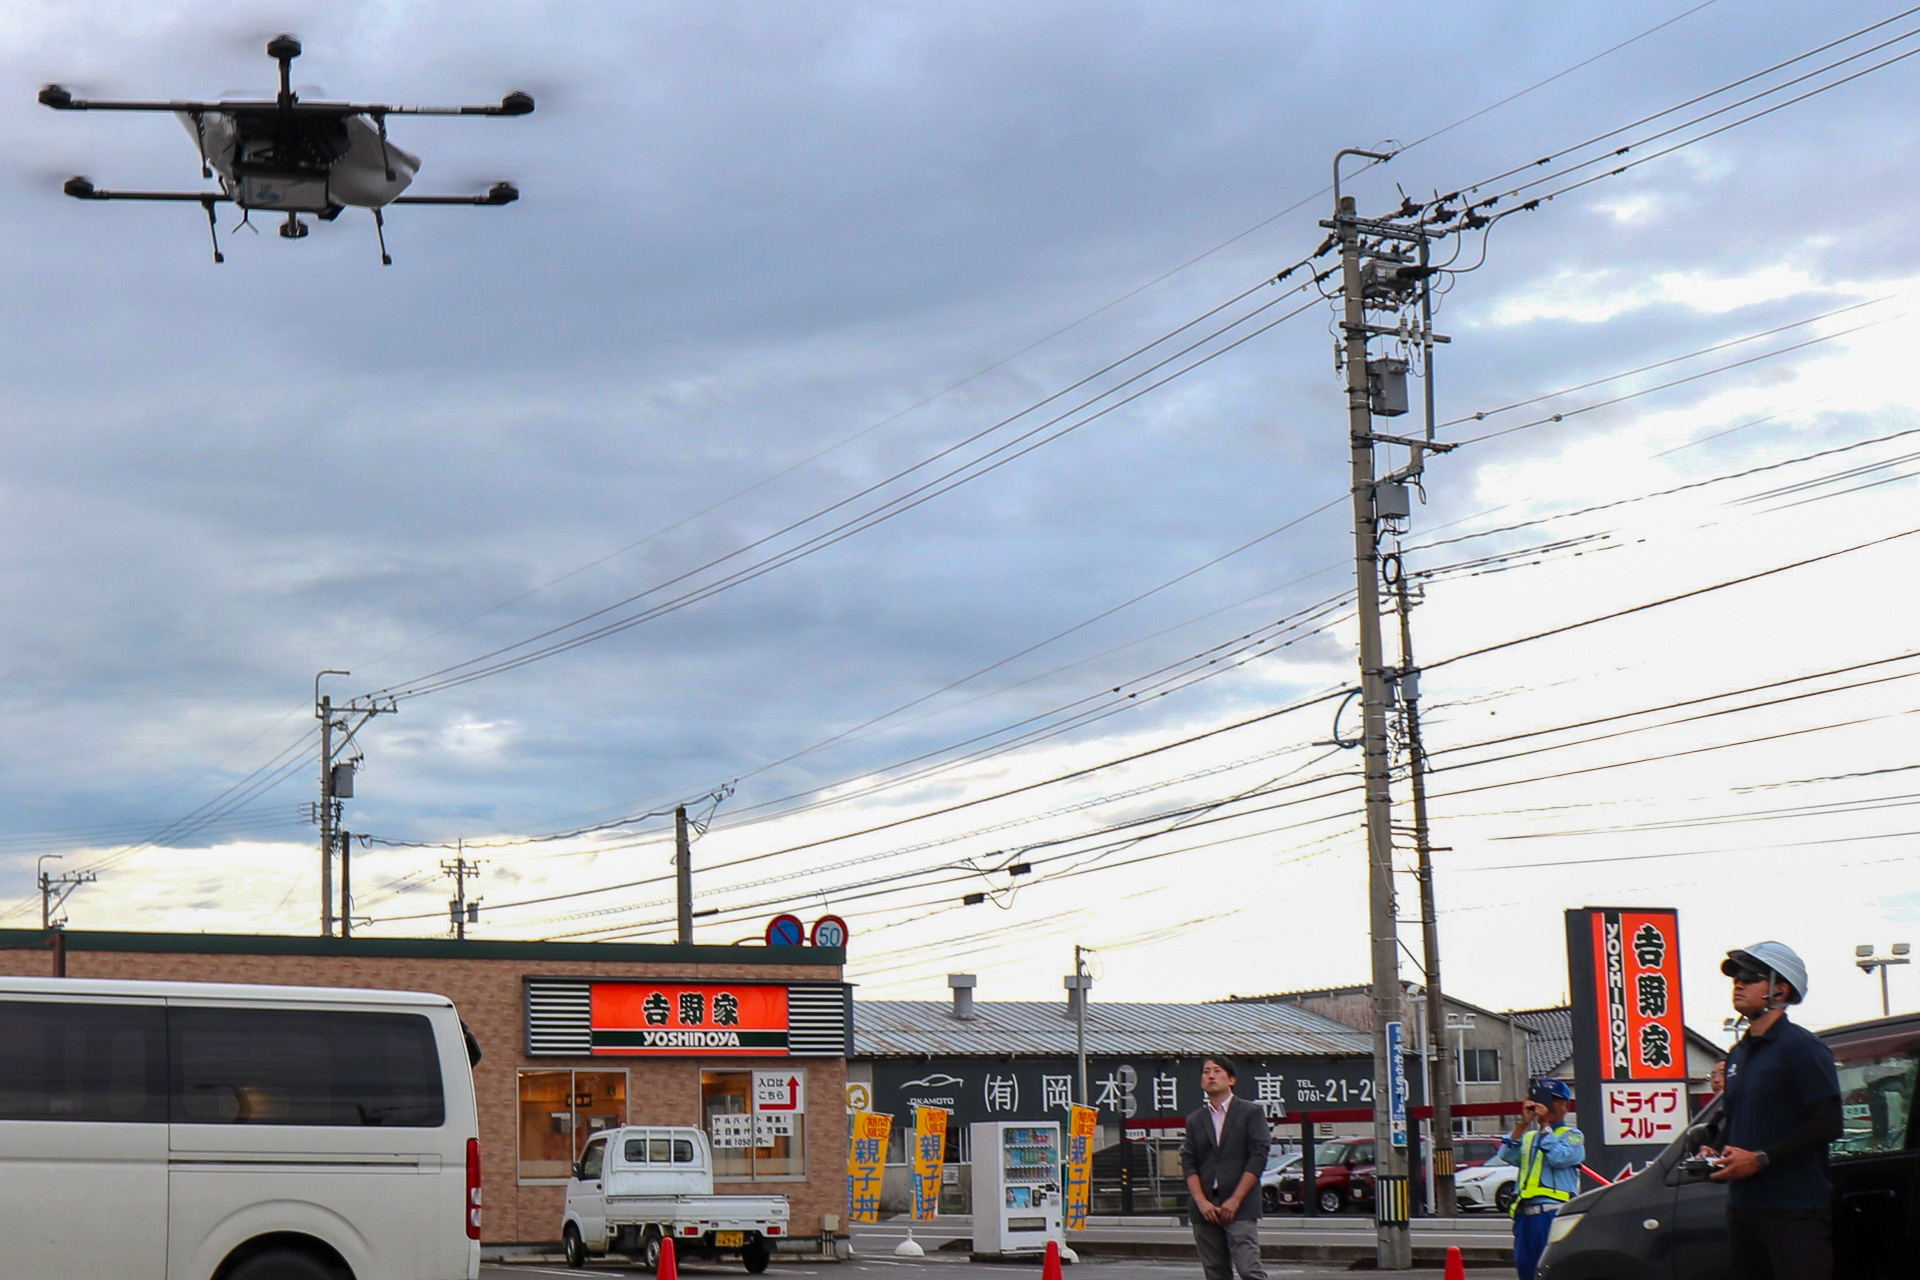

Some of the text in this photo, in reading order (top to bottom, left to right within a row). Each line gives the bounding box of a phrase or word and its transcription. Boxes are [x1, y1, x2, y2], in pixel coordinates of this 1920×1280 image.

[819, 927, 840, 946] 50
[1606, 923, 1628, 1068] YOSHINOYA
[1633, 922, 1673, 1069] 吉野家
[642, 991, 740, 1027] 吉野家
[643, 1031, 740, 1046] YOSHINOYA
[758, 1078, 784, 1087] 入口は
[759, 1091, 784, 1100] こちら
[910, 1097, 954, 1105] OKAMOTO
[1610, 1088, 1678, 1113] ドライブ
[1620, 1117, 1672, 1139] スルー
[853, 1138, 880, 1220] 親子丼
[919, 1135, 941, 1220] 親子丼
[1068, 1136, 1088, 1229] 親子丼
